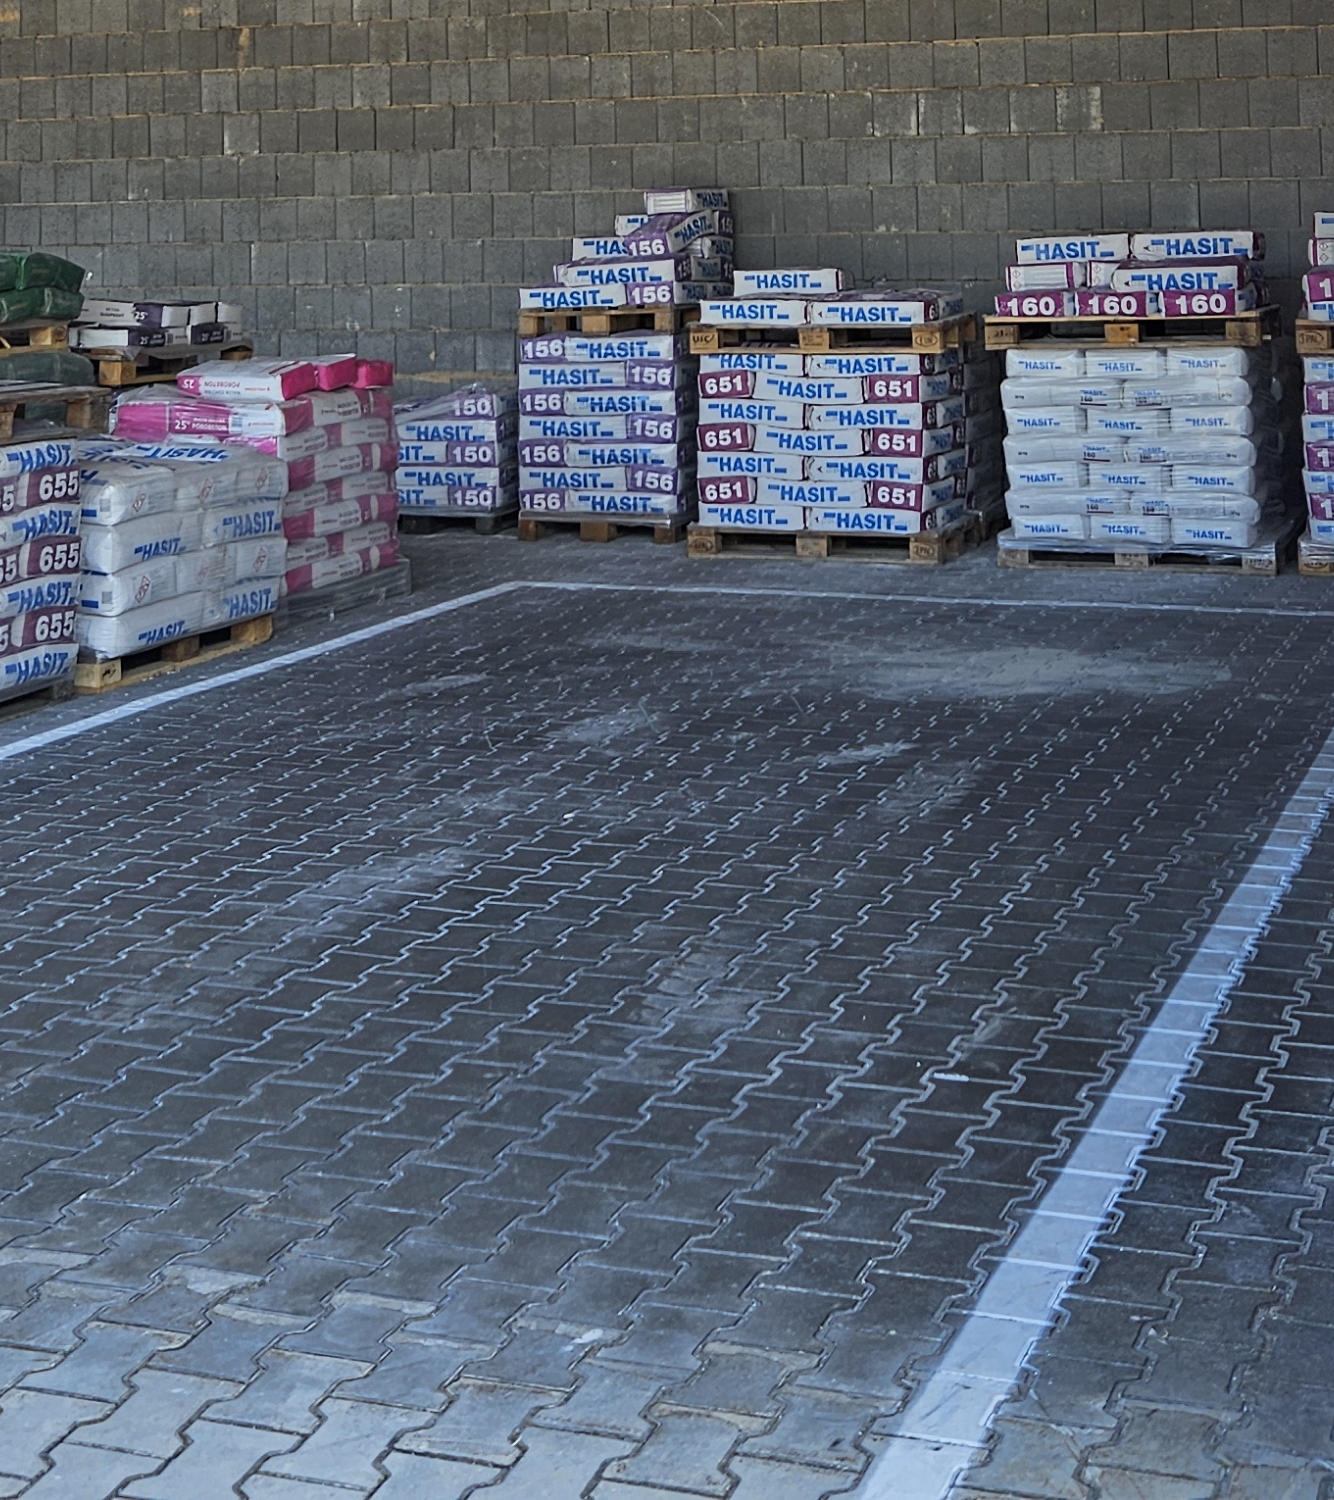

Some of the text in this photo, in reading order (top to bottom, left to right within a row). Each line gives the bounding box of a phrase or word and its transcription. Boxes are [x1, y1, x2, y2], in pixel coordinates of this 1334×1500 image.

[629, 239, 664, 256] 156
[1035, 243, 1101, 259] HASIT
[1166, 238, 1233, 256] HASIT
[590, 266, 649, 284] HASIT
[757, 272, 810, 289] HASIT
[1148, 272, 1217, 289] HASIT
[541, 286, 671, 307] HASIT 156
[1089, 296, 1137, 315] 160
[1176, 294, 1226, 314] 160
[723, 303, 777, 320] HASIT
[839, 305, 898, 322] HASIT
[1007, 297, 1055, 316] 160
[524, 340, 648, 359] 156 HASIT
[1025, 362, 1054, 370] HASIT
[1105, 363, 1135, 371] HASIT
[541, 366, 671, 386] HASIT 156
[705, 378, 912, 398] 651 HASIT 651
[417, 425, 473, 442] HASIT
[704, 430, 916, 451] 651 HASIT 651
[19, 445, 73, 470] HASIT
[453, 445, 491, 463] 150
[231, 509, 275, 536] HASIT
[142, 537, 181, 558] HASIT
